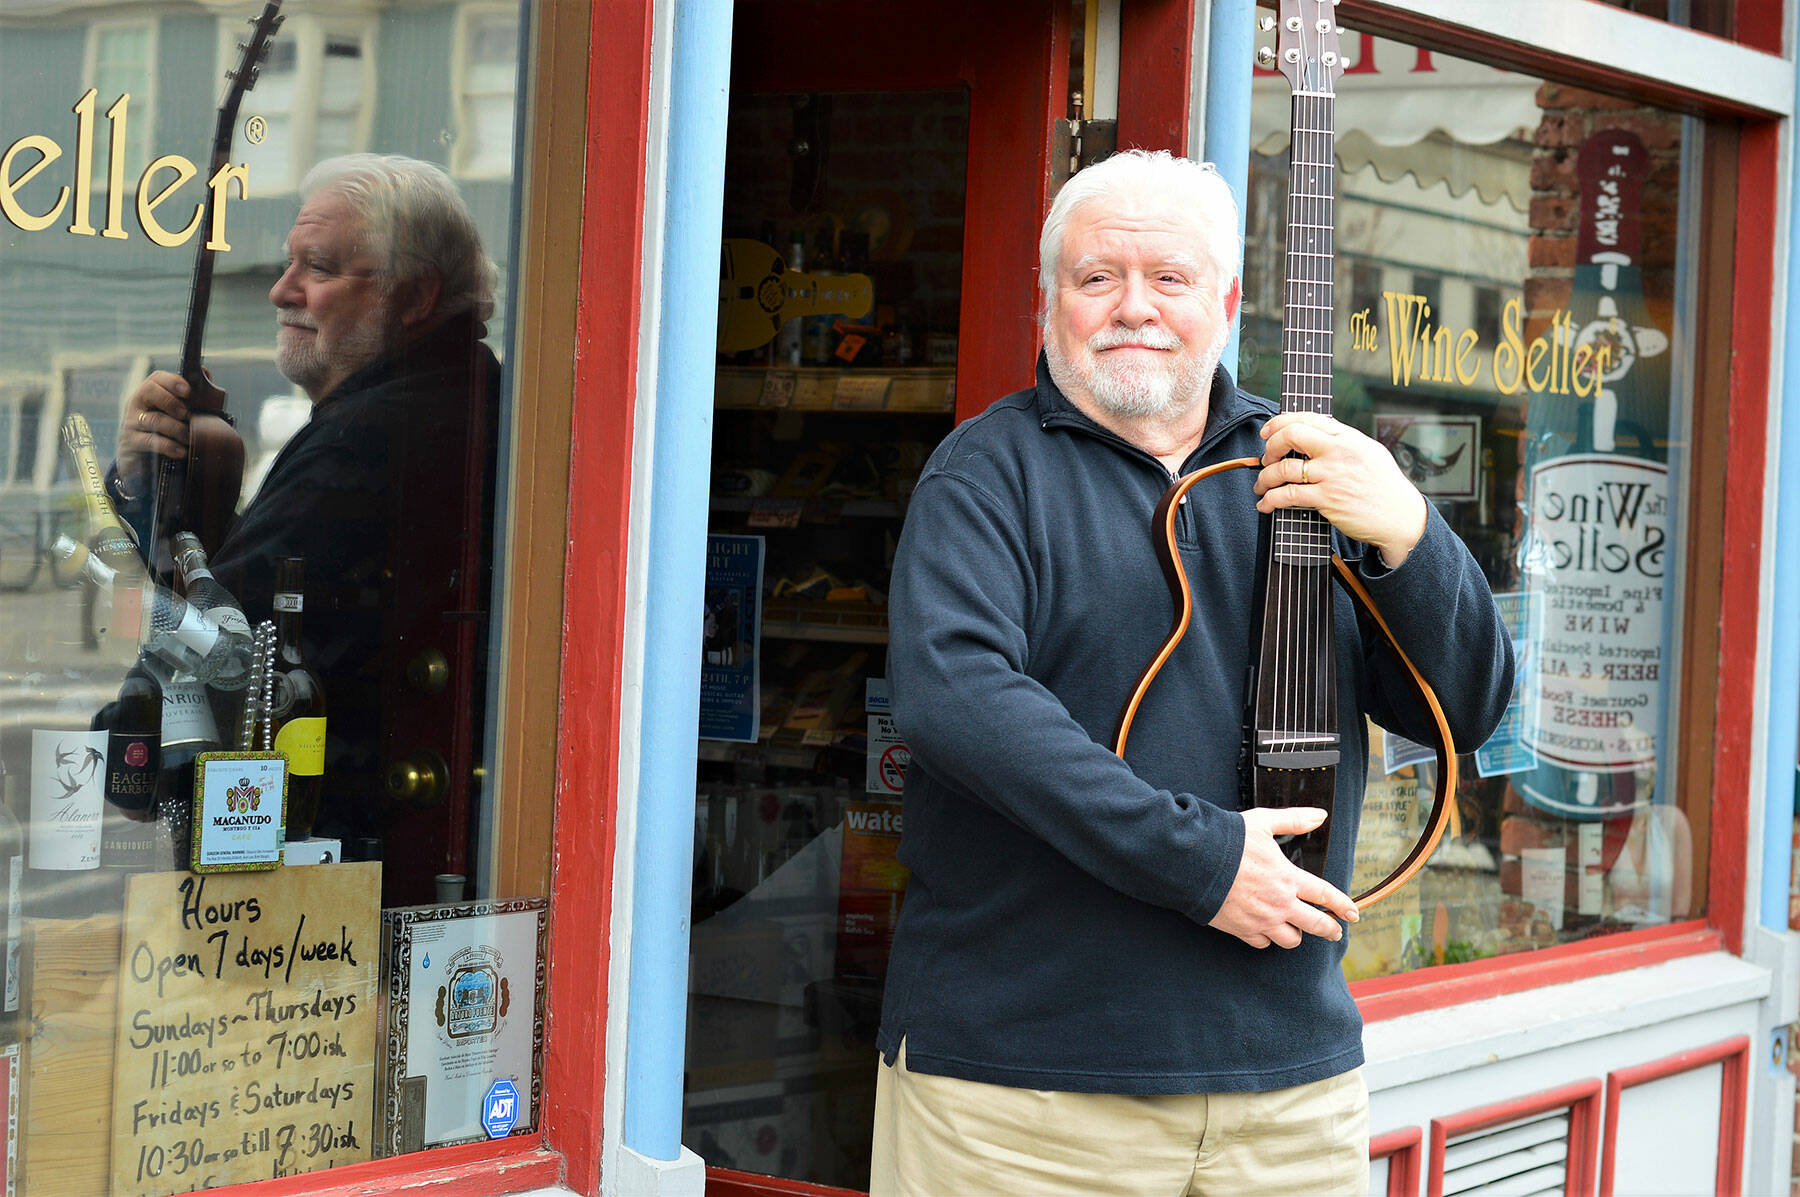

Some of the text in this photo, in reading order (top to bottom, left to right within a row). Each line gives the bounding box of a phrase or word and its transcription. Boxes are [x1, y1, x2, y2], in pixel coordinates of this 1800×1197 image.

[1350, 291, 1611, 397] The Wine Seller
[213, 815, 272, 826] MACANUDO
[178, 876, 262, 930] Hours
[131, 939, 205, 998] Open
[207, 929, 229, 979] 7
[129, 1009, 228, 1049] Sundays
[151, 1048, 202, 1089] 11:00
[202, 1059, 217, 1074] or
[239, 1042, 263, 1068] to
[133, 1099, 220, 1136] Fridays
[242, 1077, 355, 1115] Saturdays
[489, 1098, 515, 1120] ADT
[135, 1137, 205, 1183] 10:30
[239, 1127, 270, 1154] till
